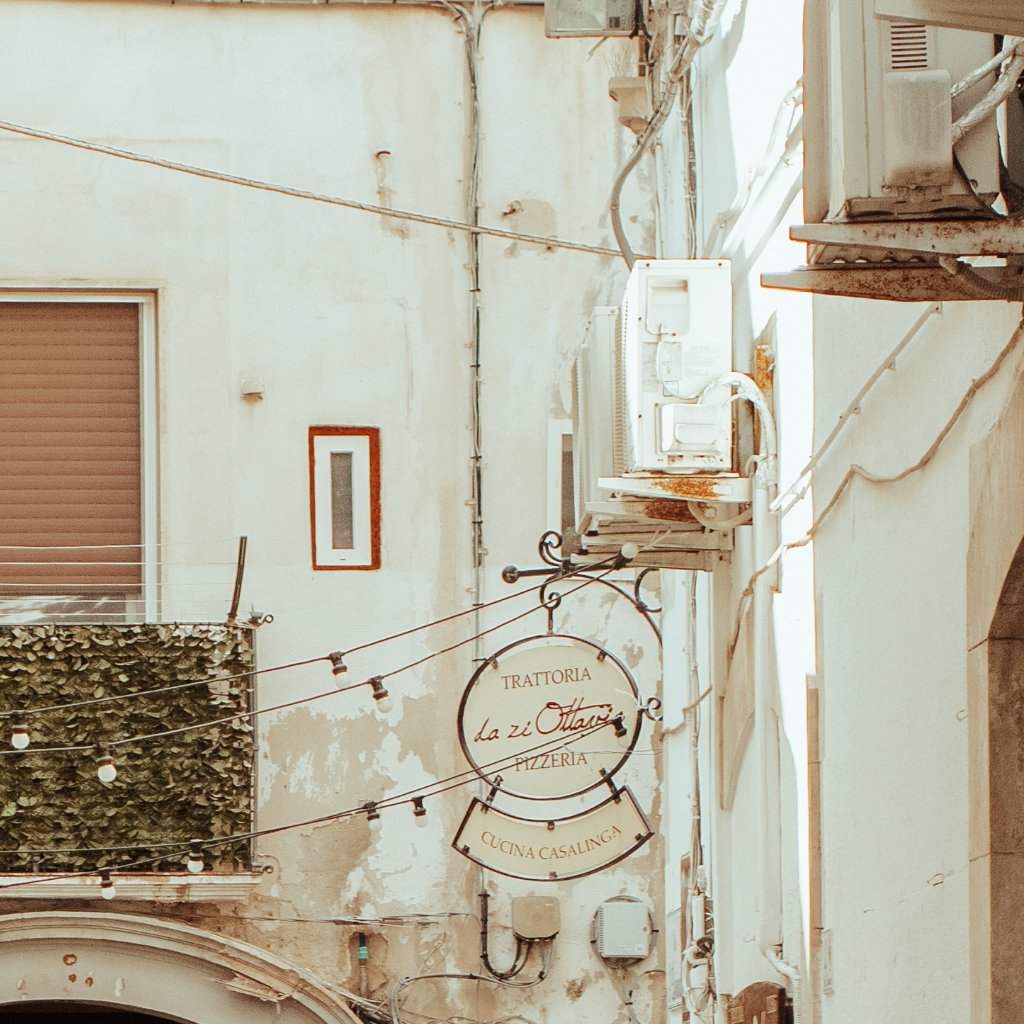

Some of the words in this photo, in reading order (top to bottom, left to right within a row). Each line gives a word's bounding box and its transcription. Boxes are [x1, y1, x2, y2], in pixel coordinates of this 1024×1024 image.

[501, 667, 592, 690] TRATTORIA
[515, 752, 588, 772] PIZZERIA
[481, 831, 535, 859] CUCINA
[539, 825, 622, 860] CASALINGA
